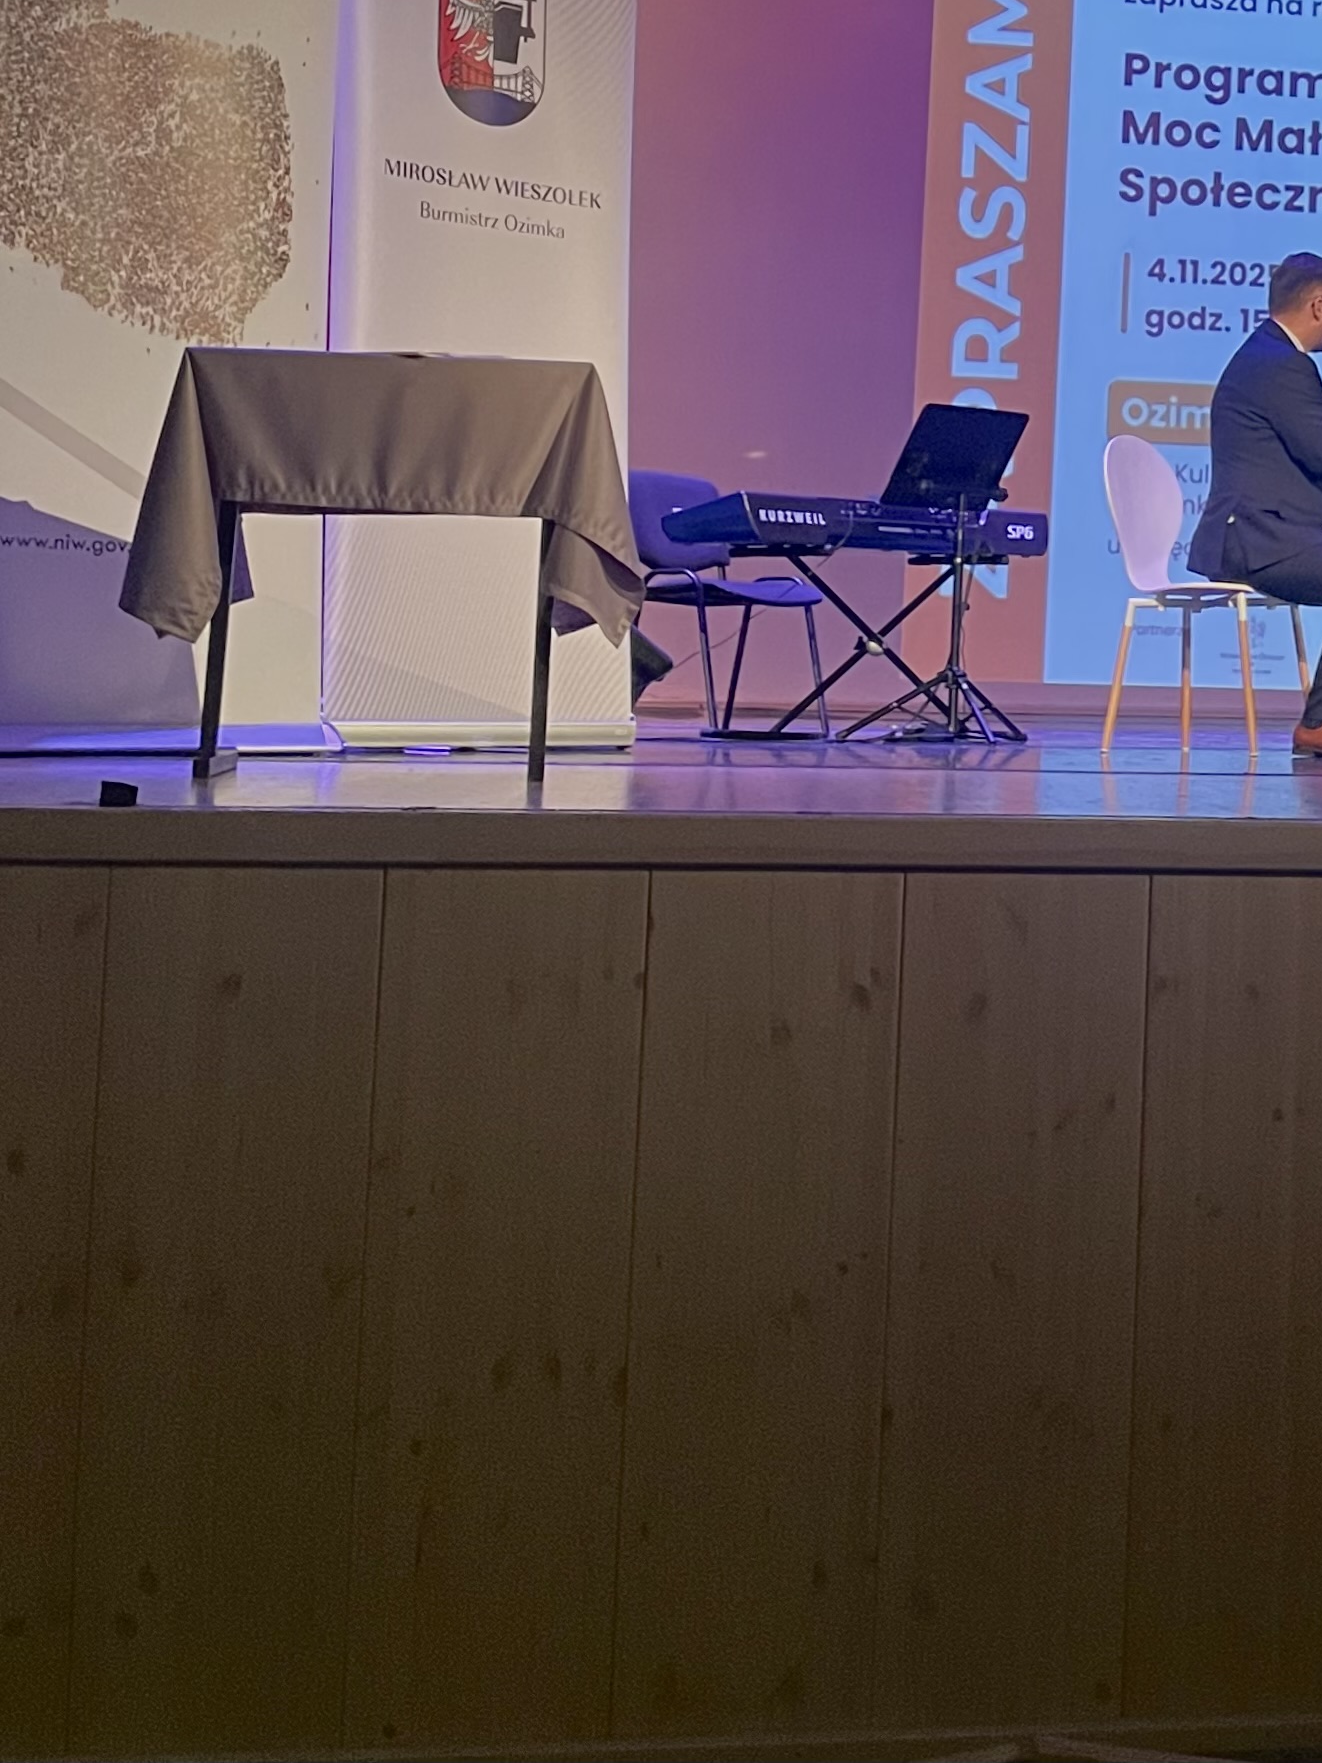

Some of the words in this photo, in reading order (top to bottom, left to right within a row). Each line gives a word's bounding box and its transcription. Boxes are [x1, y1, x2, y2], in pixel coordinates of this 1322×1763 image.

[1121, 110, 1221, 149] Moc
[420, 200, 499, 229] Burmistrz
[504, 213, 566, 238] Ozimka
[1145, 306, 1231, 337] godz.
[1121, 396, 1212, 429] Ozim
[758, 508, 826, 526] KURZWEIL
[1007, 524, 1034, 540] SP6
[0, 533, 129, 556] www.niw.gov
